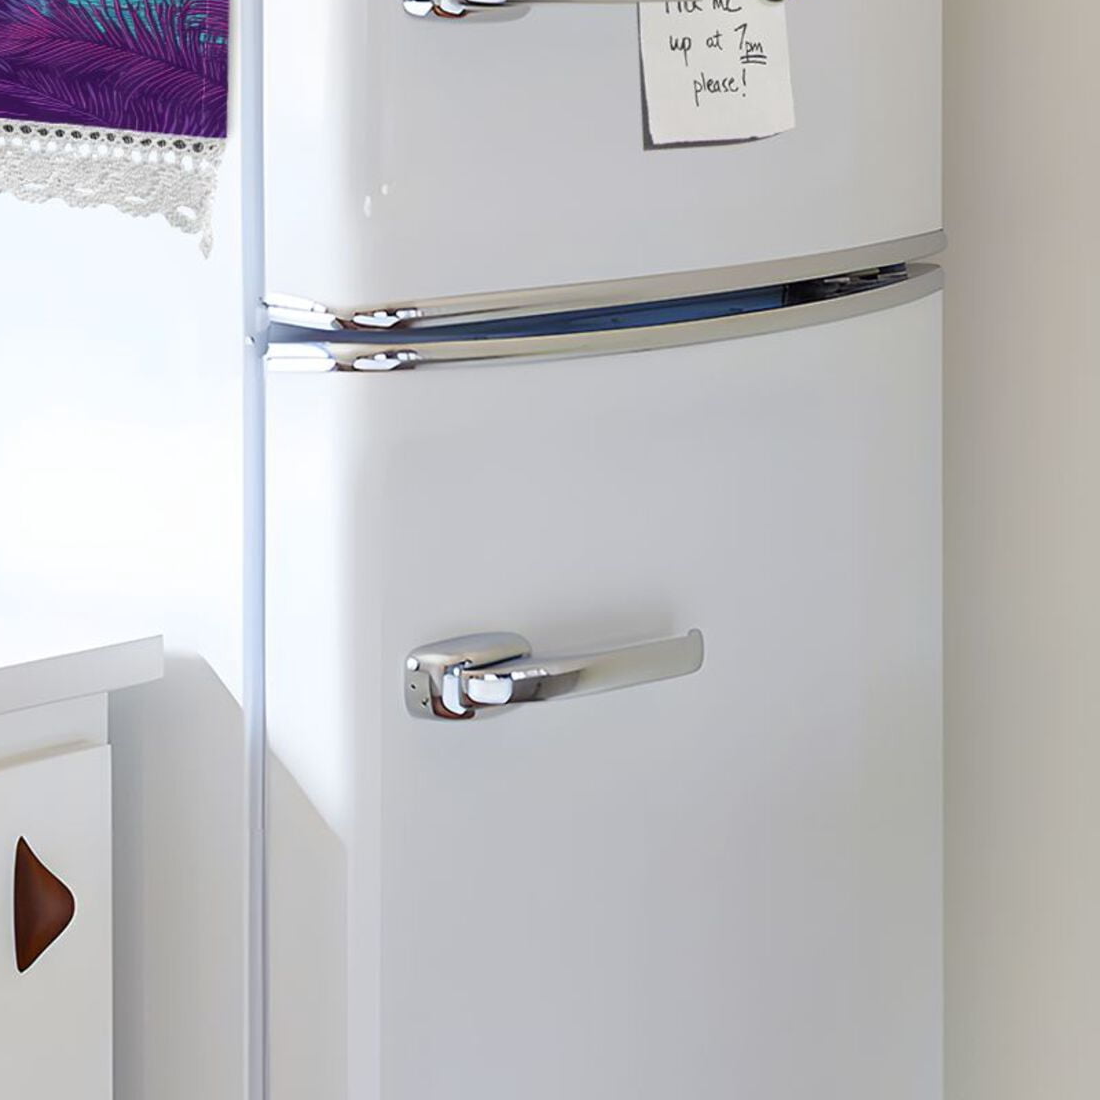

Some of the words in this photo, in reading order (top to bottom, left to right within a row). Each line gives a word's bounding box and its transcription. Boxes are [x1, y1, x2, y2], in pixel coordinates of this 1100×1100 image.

[669, 35, 693, 67] up
[705, 29, 724, 51] at
[693, 68, 747, 107] please!
